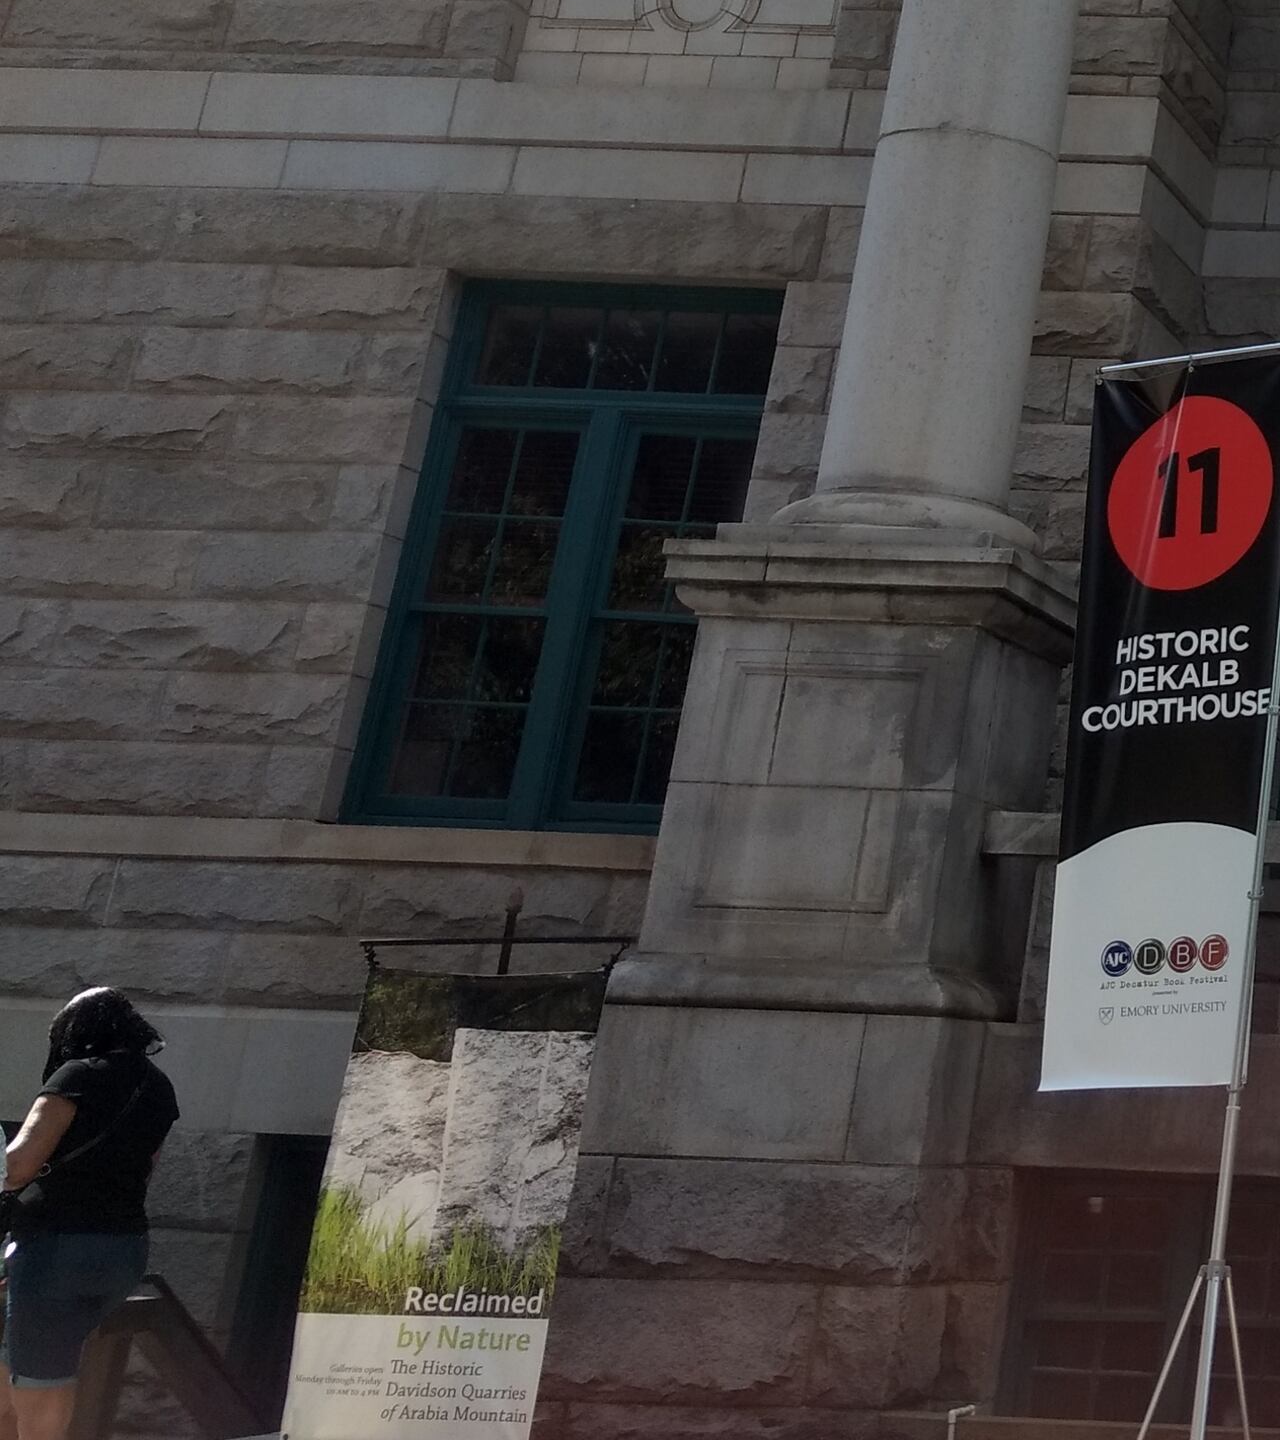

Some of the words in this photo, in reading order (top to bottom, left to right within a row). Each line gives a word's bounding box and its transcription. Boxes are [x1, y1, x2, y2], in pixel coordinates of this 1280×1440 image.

[1158, 447, 1221, 539] 11
[1116, 625, 1250, 664] HISTORIC
[1119, 659, 1239, 696] DEKALB
[1082, 688, 1272, 732] COURTHOUSE
[1105, 951, 1128, 965] AJC
[1144, 946, 1157, 967] D
[1176, 944, 1191, 965] B
[1208, 943, 1219, 962] F
[1100, 981, 1116, 990] AJC
[1120, 978, 1159, 988] Decatur
[1164, 977, 1185, 986] Book
[1190, 975, 1228, 985] Festival
[1120, 1005, 1161, 1017] EMORY
[1162, 1001, 1227, 1014] UNIVERSITY
[405, 1287, 544, 1315] Reclaimed
[396, 1322, 432, 1356] by
[437, 1324, 530, 1352] Nature
[391, 1359, 418, 1376] The
[422, 1361, 483, 1377] Historic
[385, 1383, 457, 1400] Davidson
[461, 1385, 526, 1401] Quarries
[380, 1405, 397, 1422] of
[399, 1406, 448, 1421] Arabia
[453, 1407, 528, 1424] Mountain
